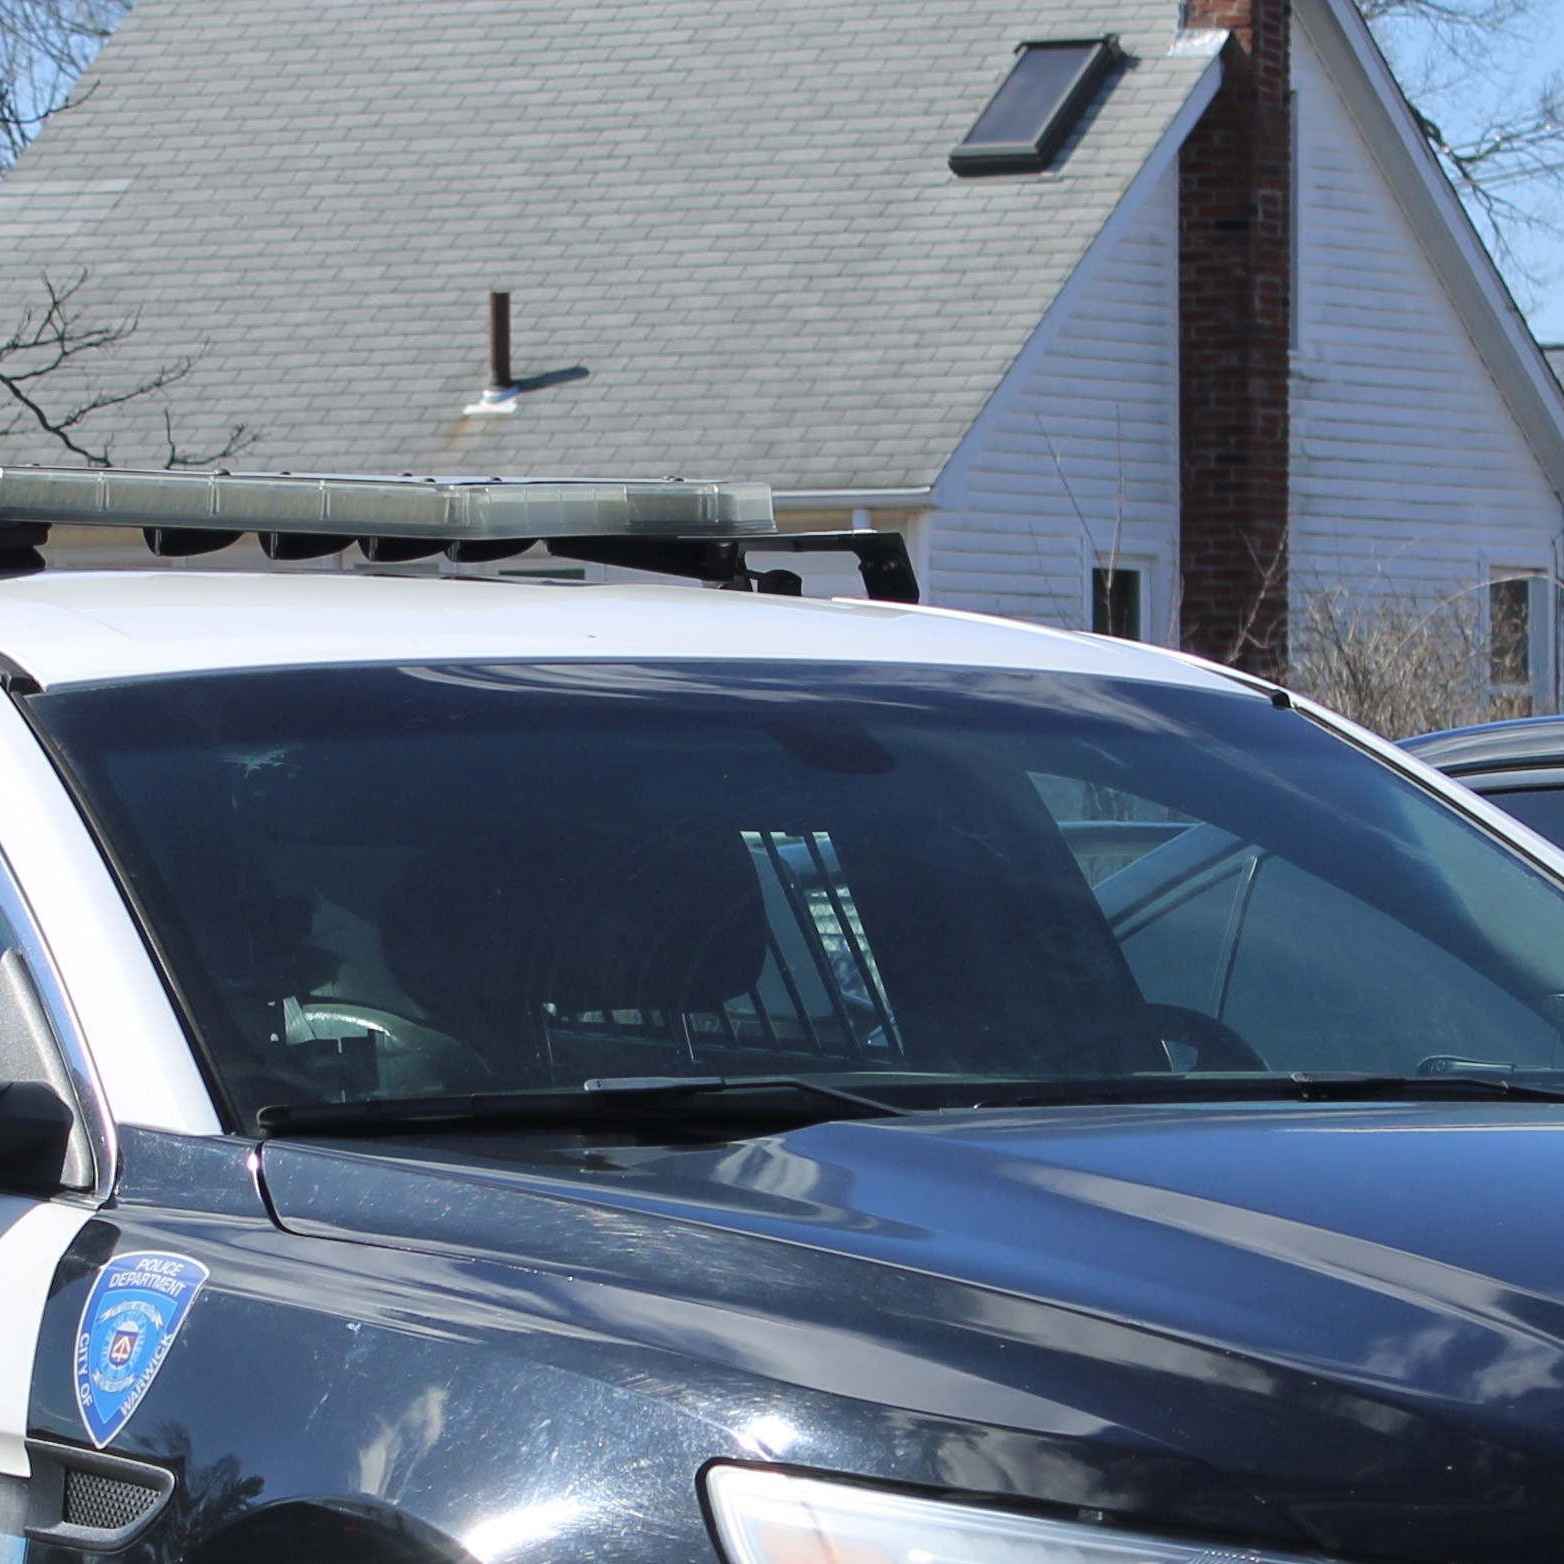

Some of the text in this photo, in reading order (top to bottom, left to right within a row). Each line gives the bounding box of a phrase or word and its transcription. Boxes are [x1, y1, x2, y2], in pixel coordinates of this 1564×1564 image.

[136, 1257, 185, 1276] POLICE
[108, 1271, 186, 1298] DEPARTMENT
[78, 1332, 90, 1375] CITY
[120, 1332, 174, 1417] WARWICK
[79, 1383, 94, 1408] OF
